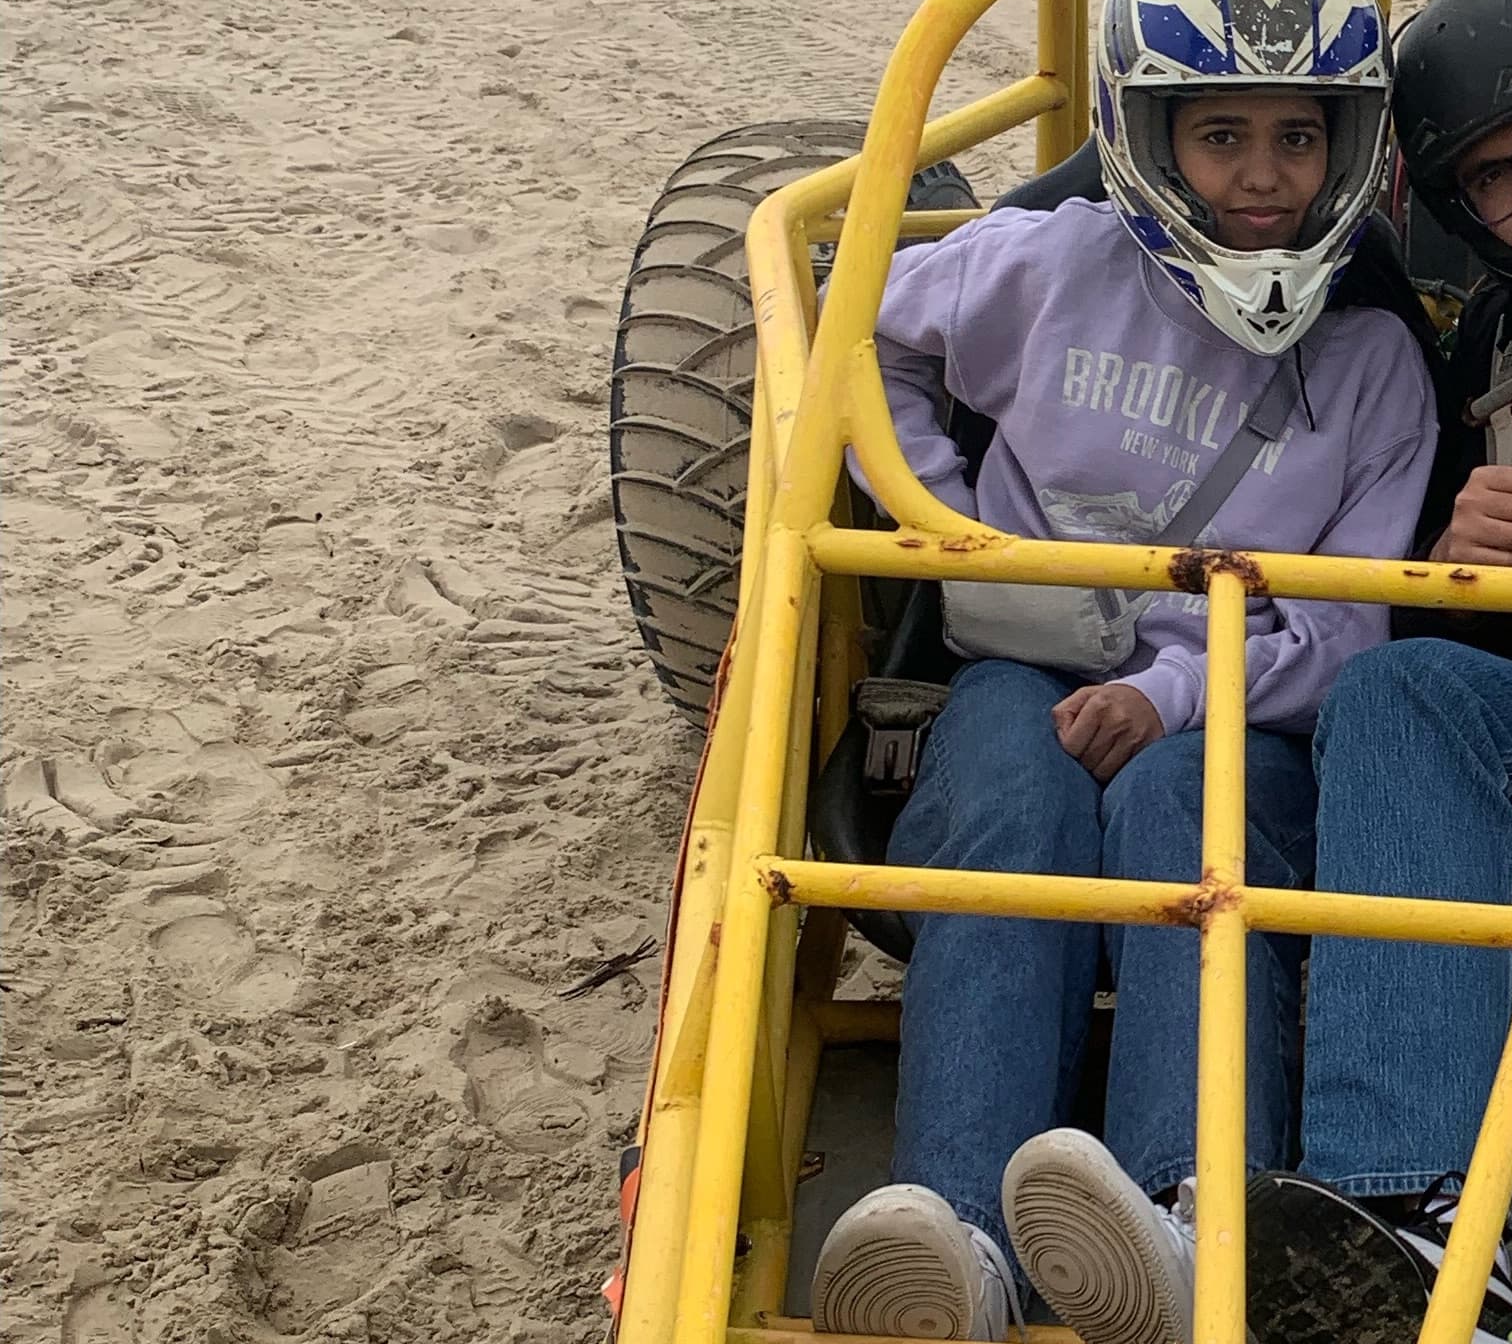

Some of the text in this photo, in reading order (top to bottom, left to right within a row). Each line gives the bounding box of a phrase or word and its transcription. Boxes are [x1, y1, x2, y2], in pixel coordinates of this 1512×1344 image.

[1062, 347, 1294, 475] BROOKLN
[1119, 428, 1201, 477] NEW YORK
